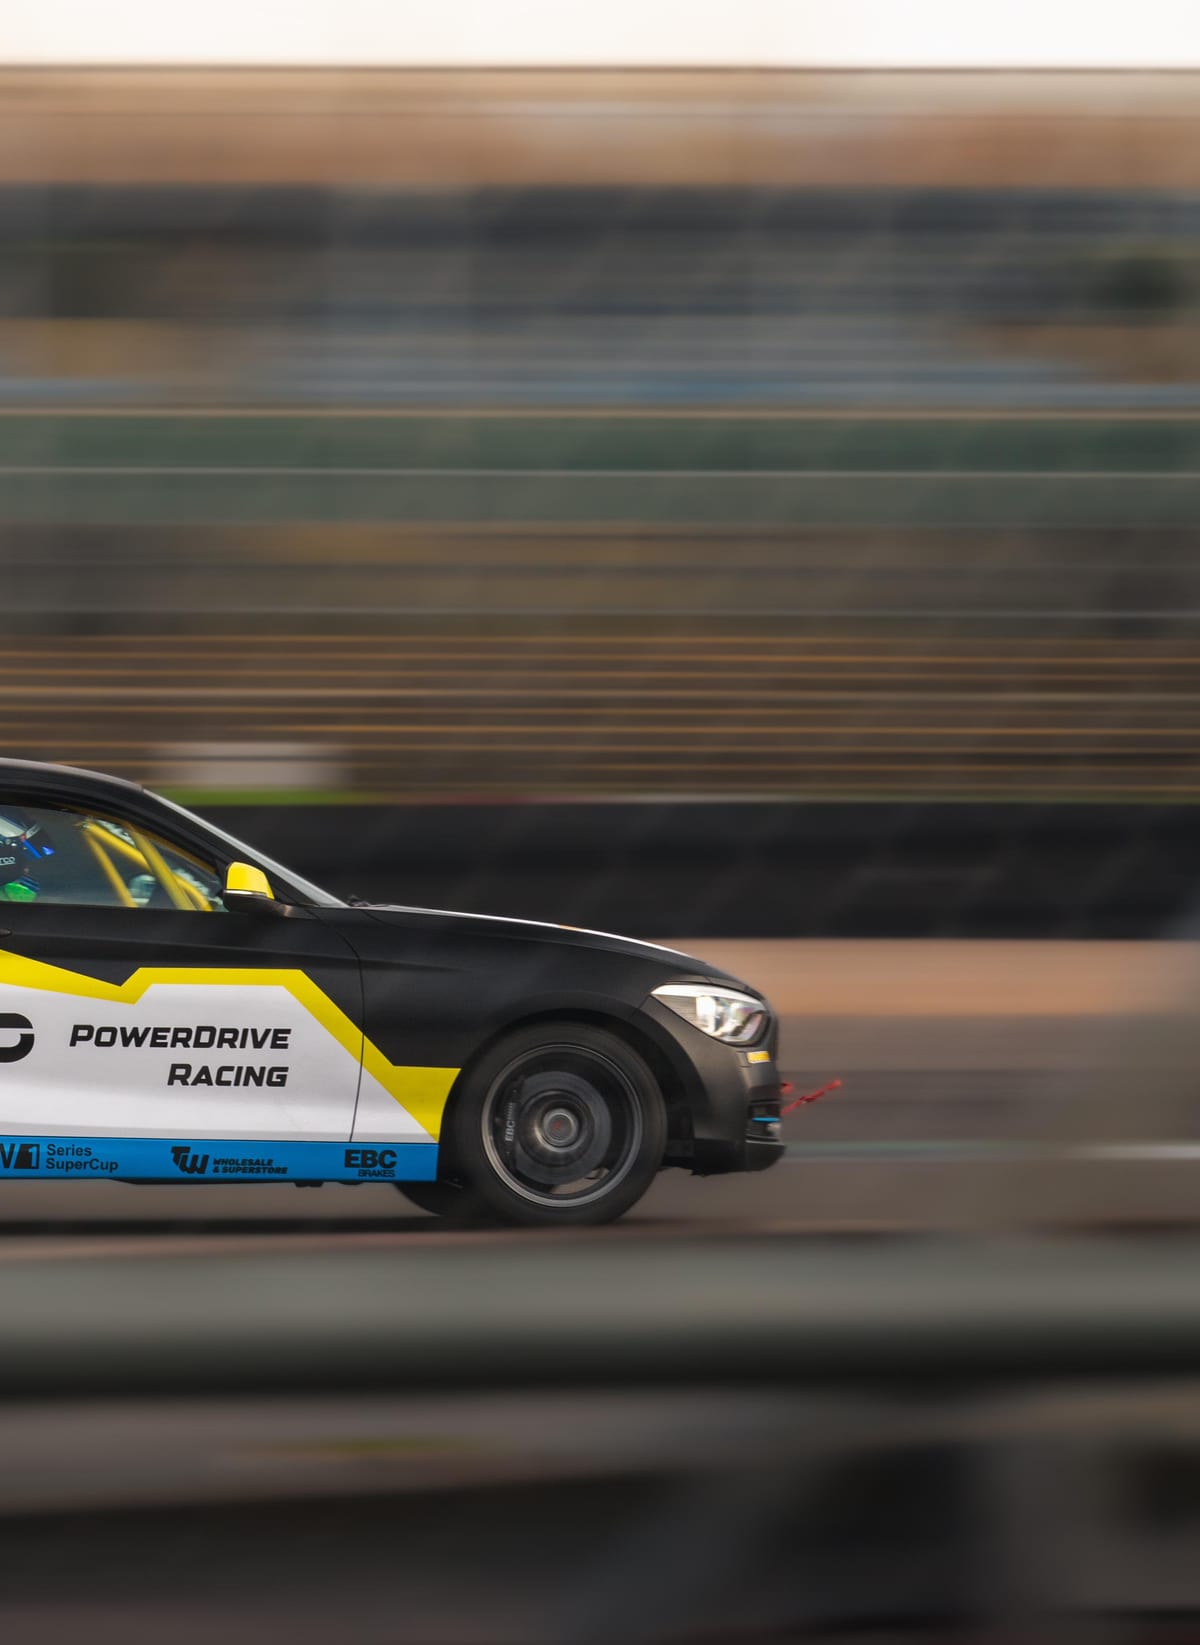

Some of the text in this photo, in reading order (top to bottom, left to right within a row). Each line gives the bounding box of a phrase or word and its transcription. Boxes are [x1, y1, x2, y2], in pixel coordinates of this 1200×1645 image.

[167, 1063, 289, 1087] RACING
[46, 1143, 92, 1157] Series
[46, 1158, 119, 1173] SuperCup
[213, 1158, 273, 1167] WHOLESALE
[344, 1149, 398, 1169] EBC
[212, 1166, 288, 1174] & SUPERSTORE
[358, 1169, 396, 1178] BRAKES
